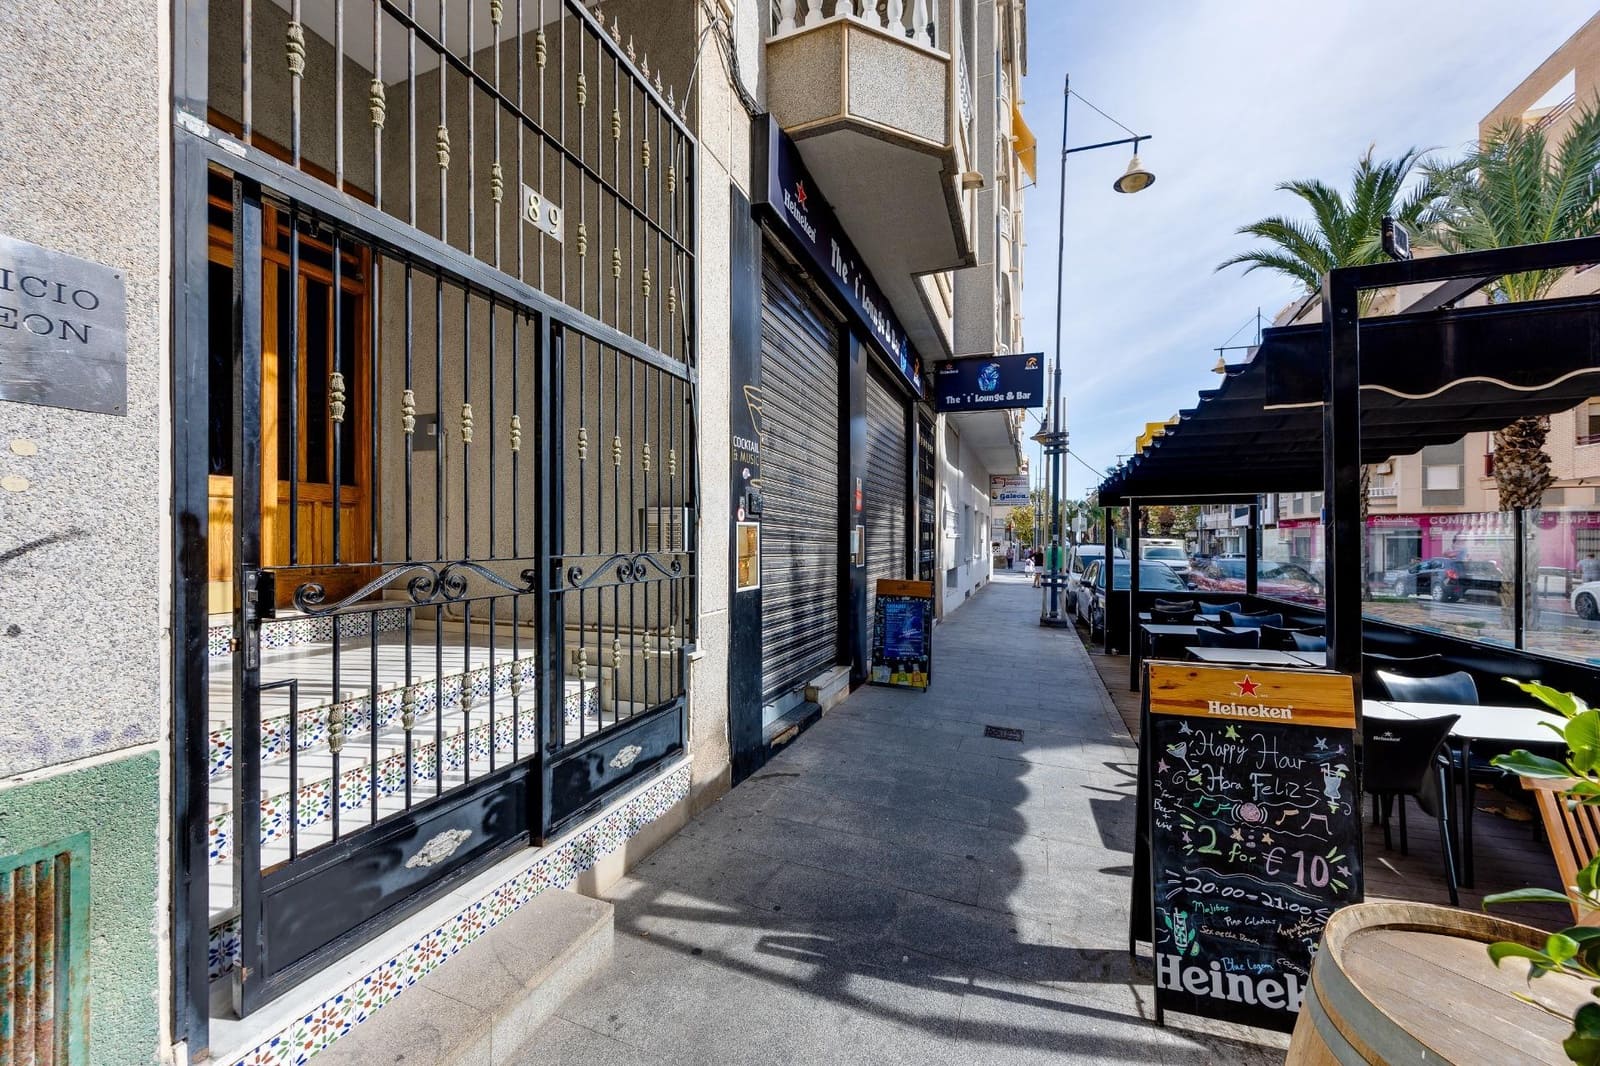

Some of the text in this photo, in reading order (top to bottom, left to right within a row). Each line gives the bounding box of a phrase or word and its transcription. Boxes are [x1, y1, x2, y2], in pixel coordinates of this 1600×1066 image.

[528, 194, 560, 234] 89
[784, 188, 816, 244] Heineken
[831, 237, 848, 284] The
[0, 268, 99, 311] ICIO
[945, 396, 960, 405] The
[975, 394, 1004, 403] Lounge
[1006, 391, 1014, 401] &
[1016, 391, 1031, 400] Bar
[733, 435, 759, 454] COCKTAIL
[740, 451, 759, 466] MUSIC
[1207, 700, 1293, 720] Heineken
[1195, 730, 1249, 764] Happy
[1202, 763, 1302, 801] Hora Feliz
[1154, 798, 1177, 813] Beer
[1197, 825, 1222, 855] 2
[1228, 843, 1256, 863] for
[1221, 957, 1246, 971] Blue
